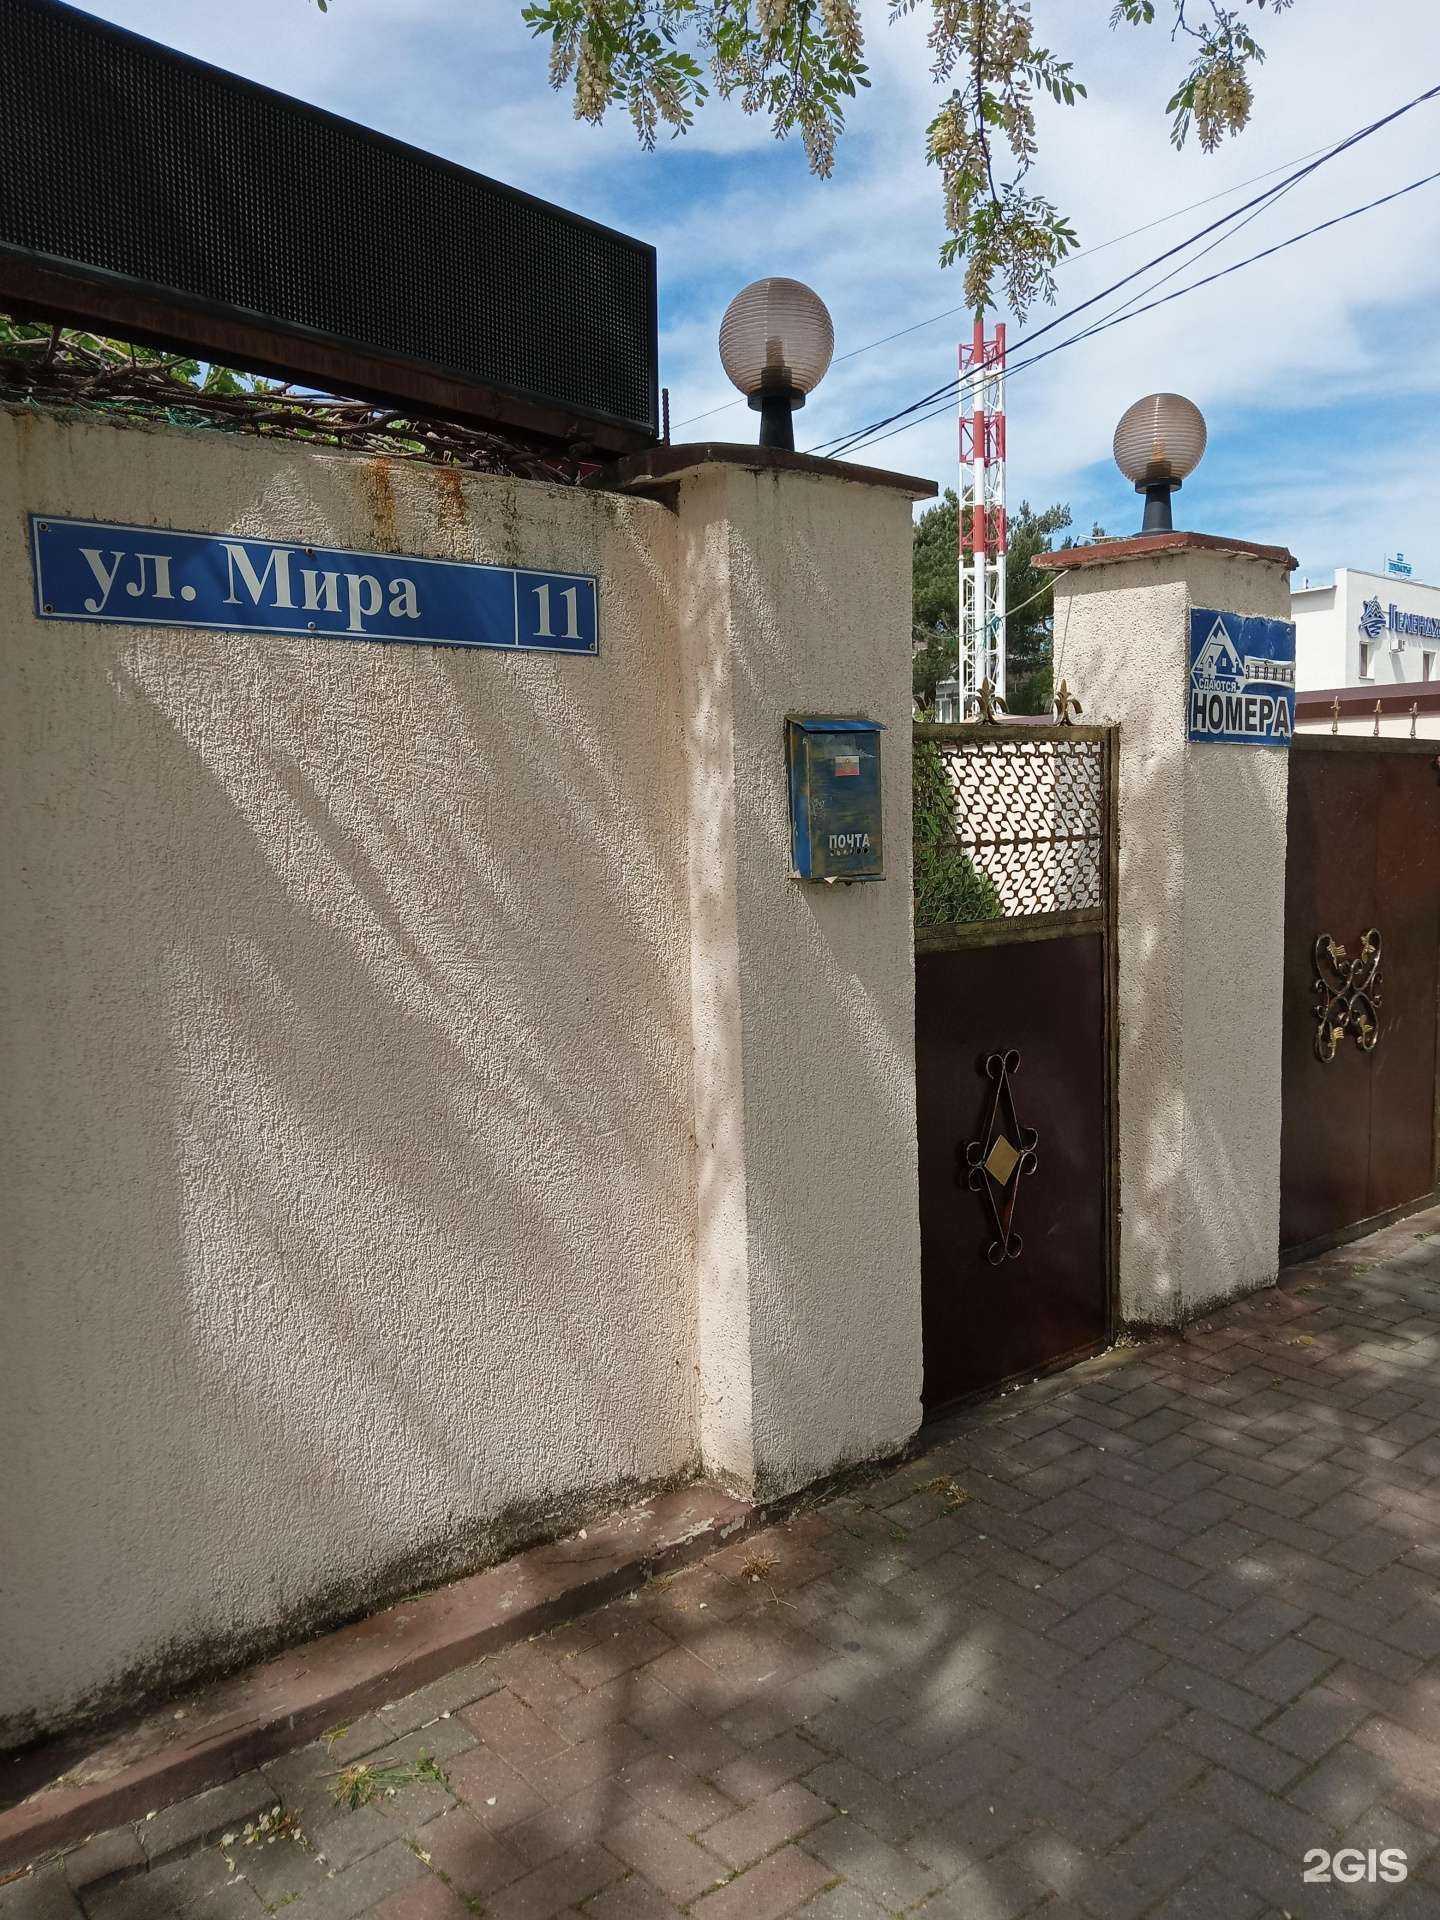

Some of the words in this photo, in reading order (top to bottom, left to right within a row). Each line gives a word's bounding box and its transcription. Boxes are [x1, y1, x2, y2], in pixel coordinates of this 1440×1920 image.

[79, 548, 196, 613] ул.
[220, 543, 421, 632] Мира
[531, 584, 583, 640] 11
[1198, 678, 1237, 692] СДАЮТСЯ
[1191, 690, 1291, 737] НОМЕРА
[829, 833, 870, 849] ПОЧТА
